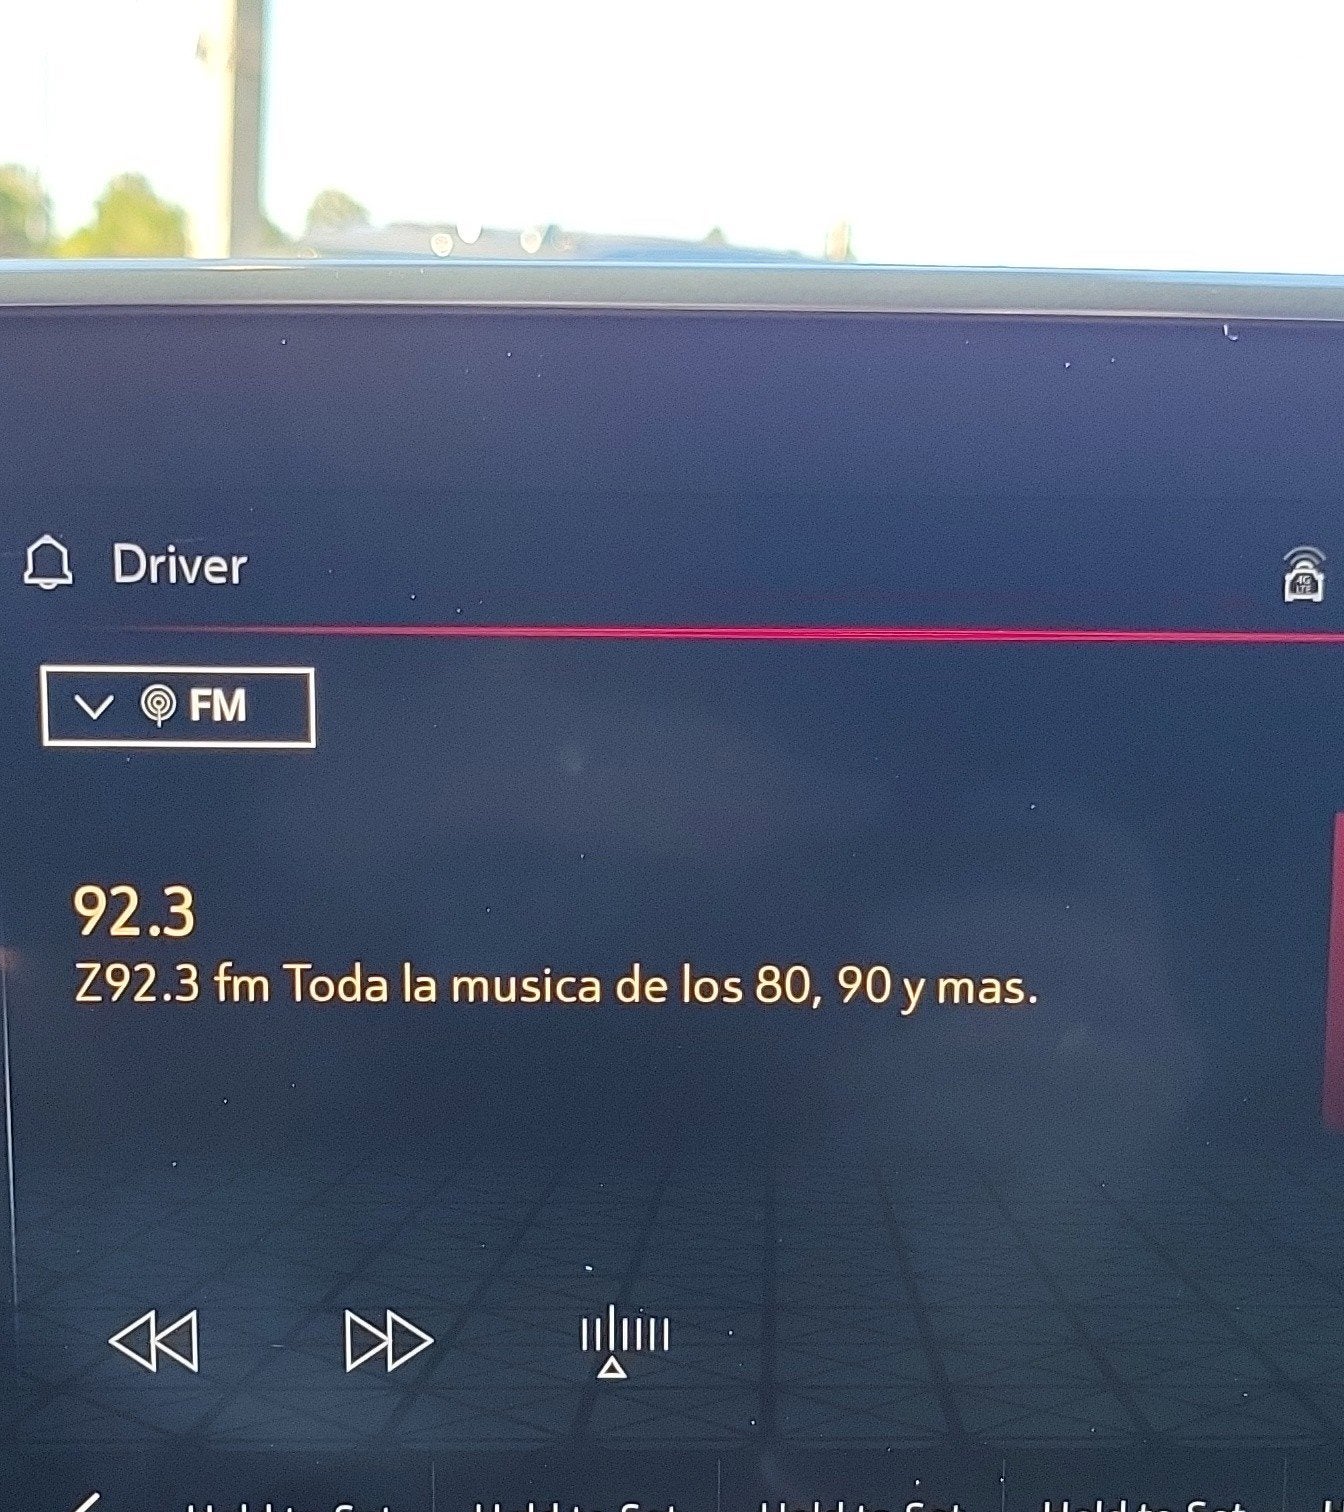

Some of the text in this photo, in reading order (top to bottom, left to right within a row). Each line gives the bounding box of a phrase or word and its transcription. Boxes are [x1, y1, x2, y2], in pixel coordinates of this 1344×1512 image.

[113, 542, 248, 585] Driver
[190, 687, 247, 722] FM
[73, 884, 195, 938] 92.3
[75, 961, 1038, 1017] Z92.3 fm Toda la musica de los 80, 90 y mas.
